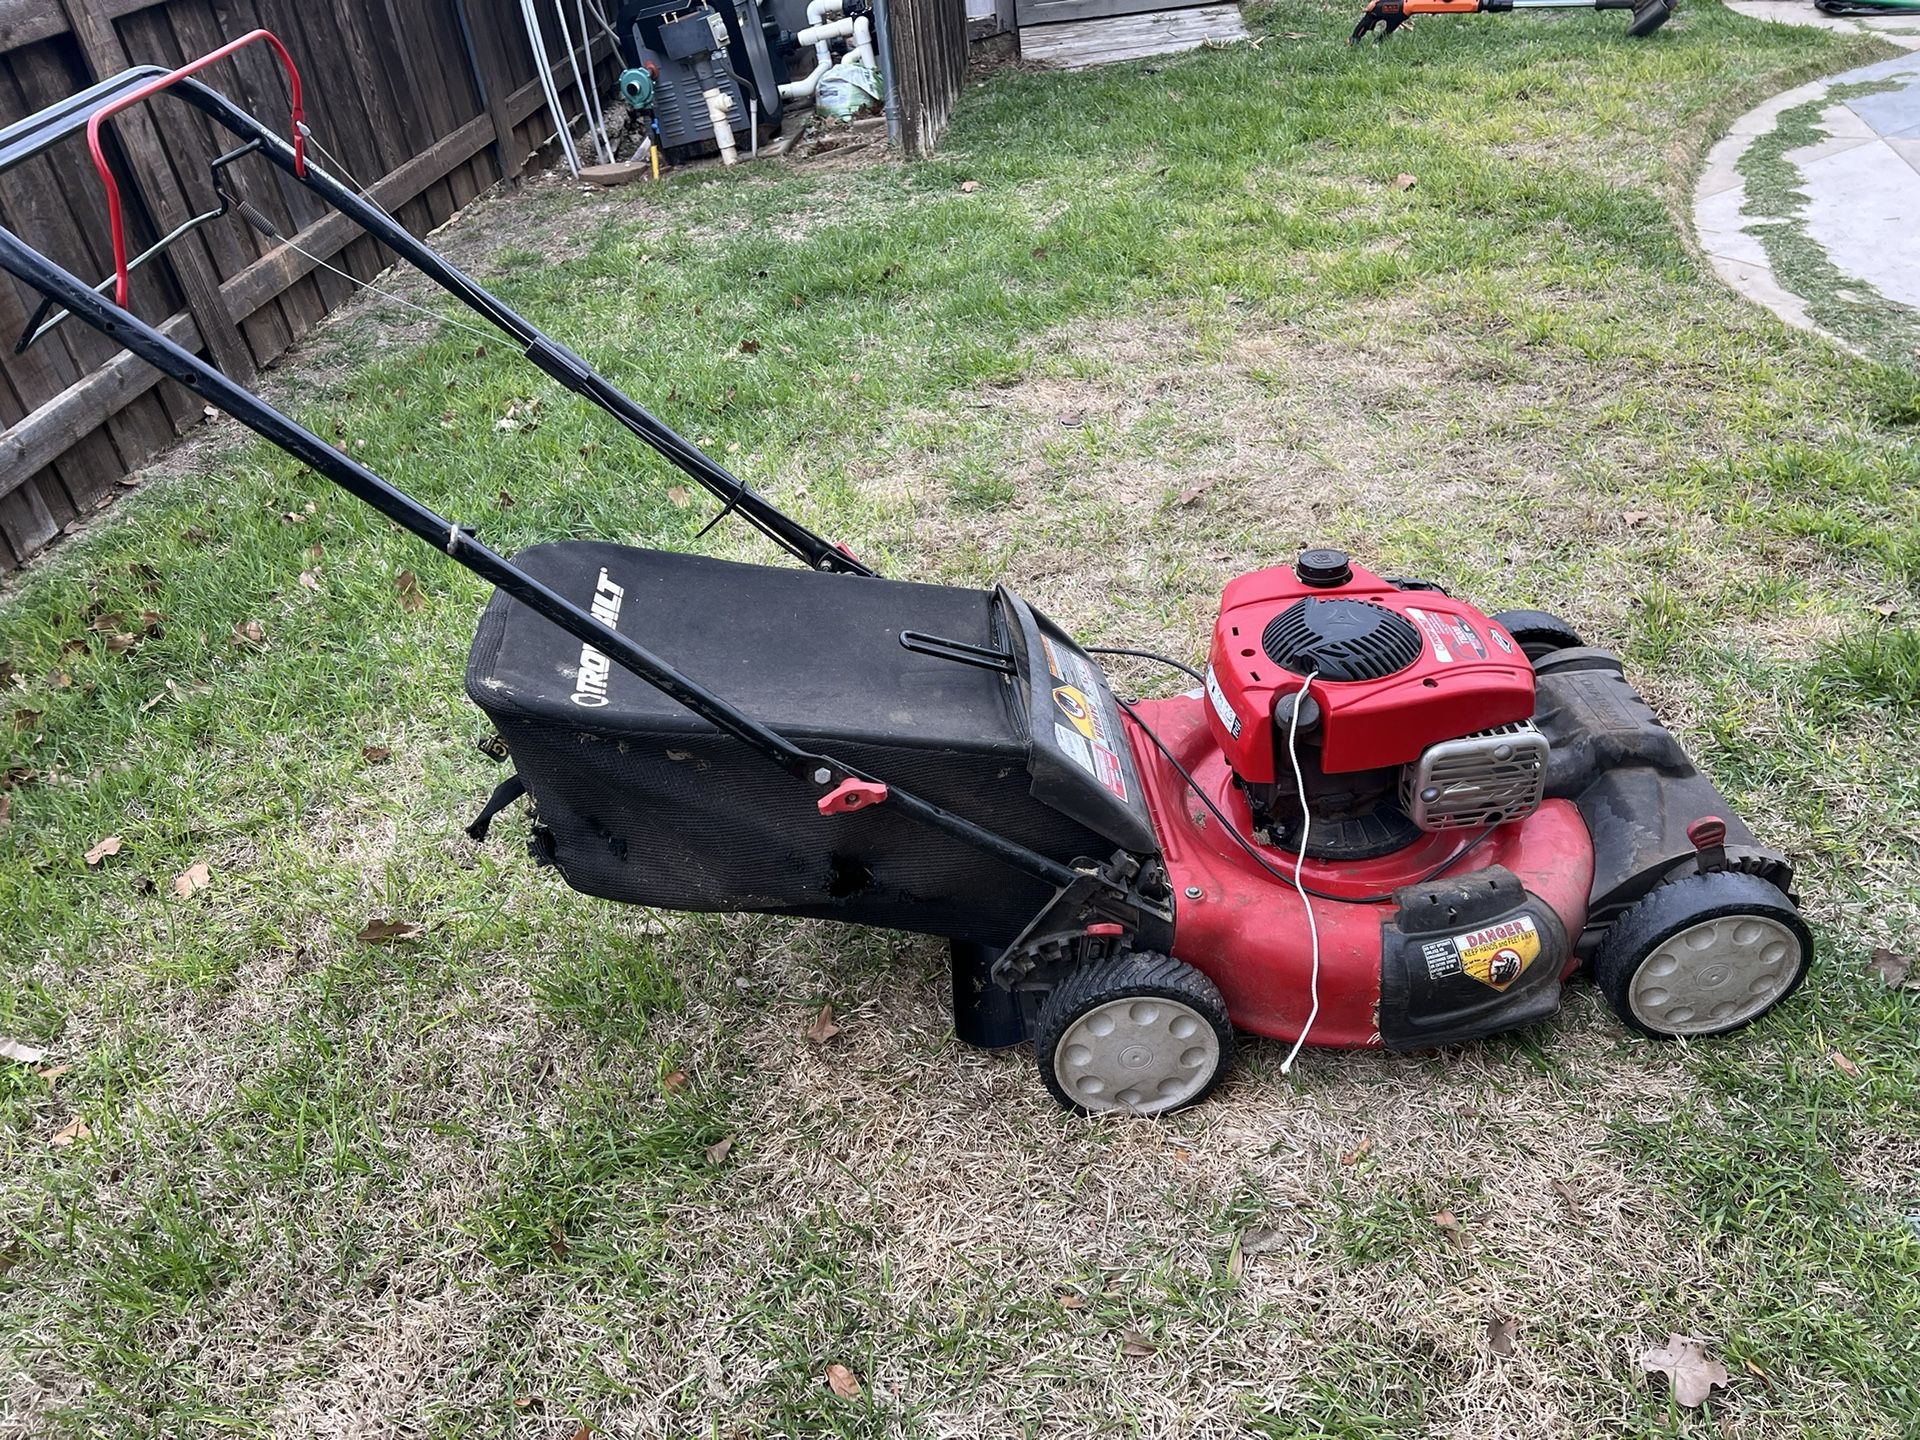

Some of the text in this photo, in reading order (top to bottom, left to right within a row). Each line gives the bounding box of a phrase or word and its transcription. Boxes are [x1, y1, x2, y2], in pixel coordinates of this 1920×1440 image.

[1088, 703, 1105, 740] DANGER
[1464, 949, 1479, 957] KEEP
[1479, 942, 1498, 953] HANDS
[1508, 935, 1520, 945] FEET
[1521, 932, 1535, 941] AWAY
[1466, 921, 1524, 948] DANGER
